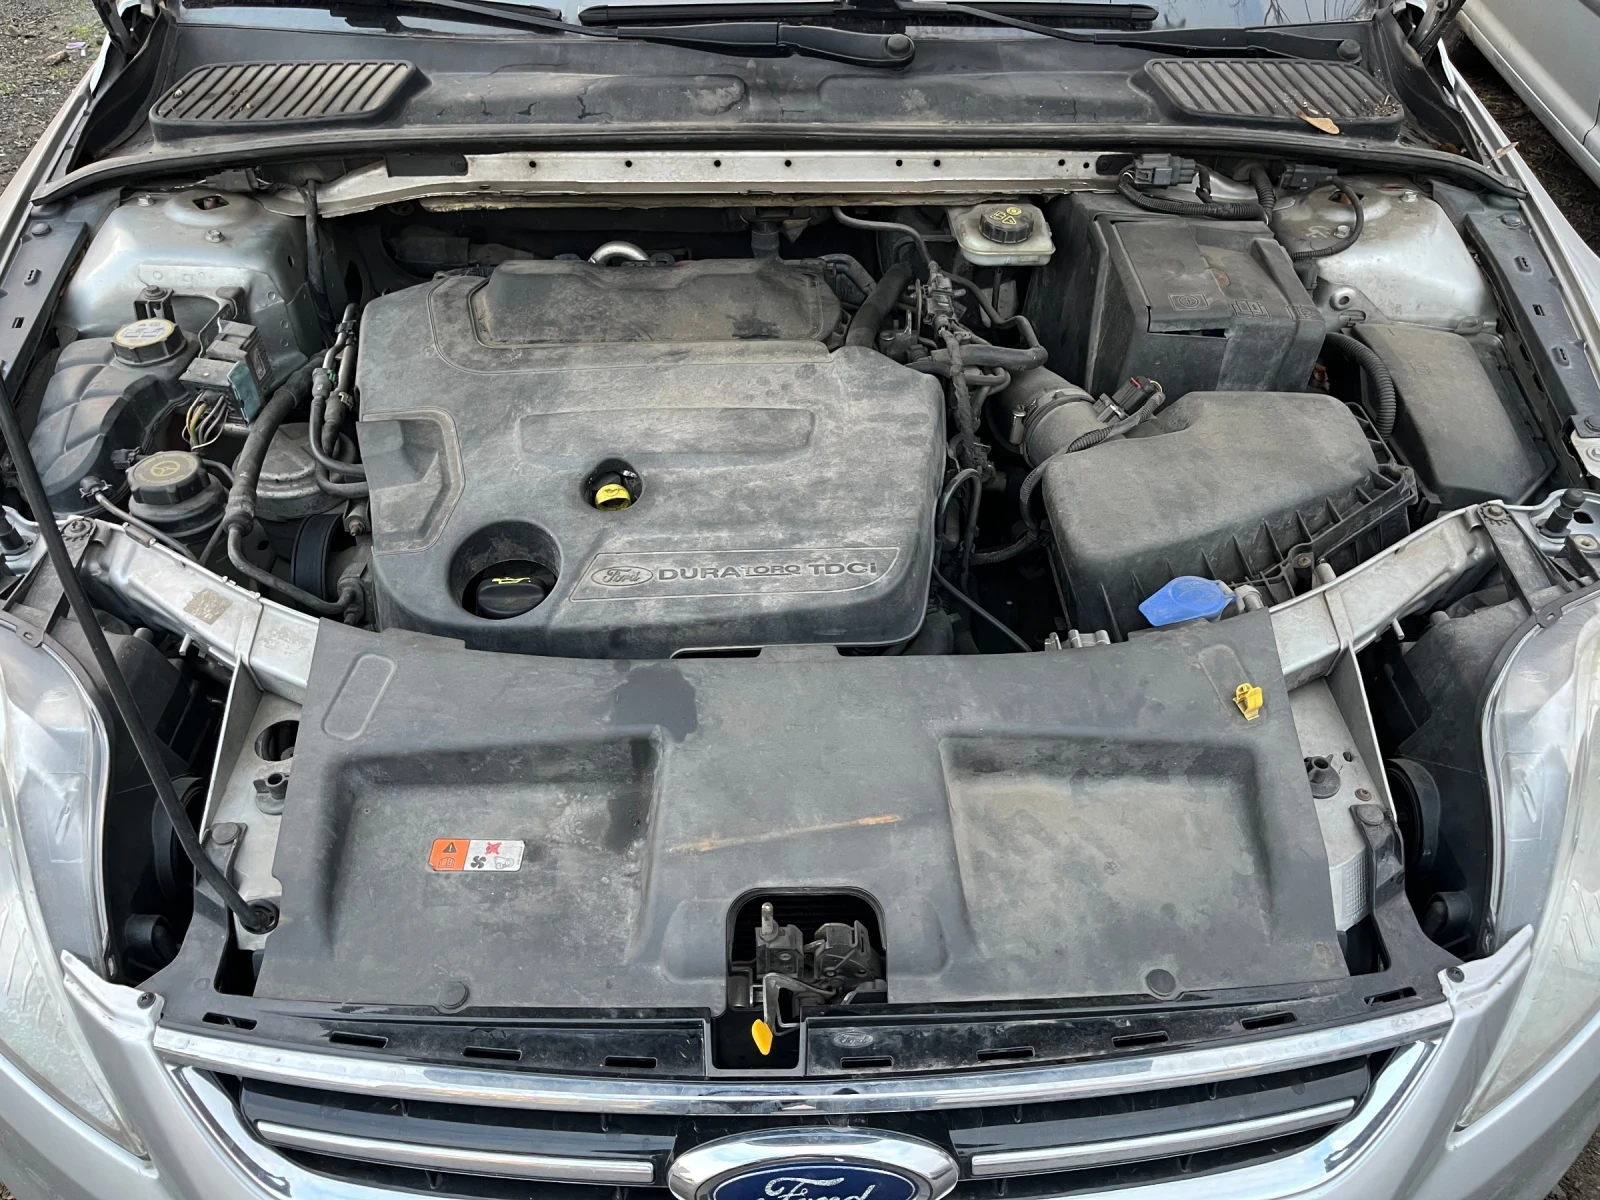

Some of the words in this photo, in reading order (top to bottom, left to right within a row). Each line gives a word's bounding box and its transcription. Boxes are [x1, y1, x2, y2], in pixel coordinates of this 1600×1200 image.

[603, 569, 641, 583] Ford
[807, 562, 877, 576] TDCi
[756, 1177, 876, 1200] Fd
